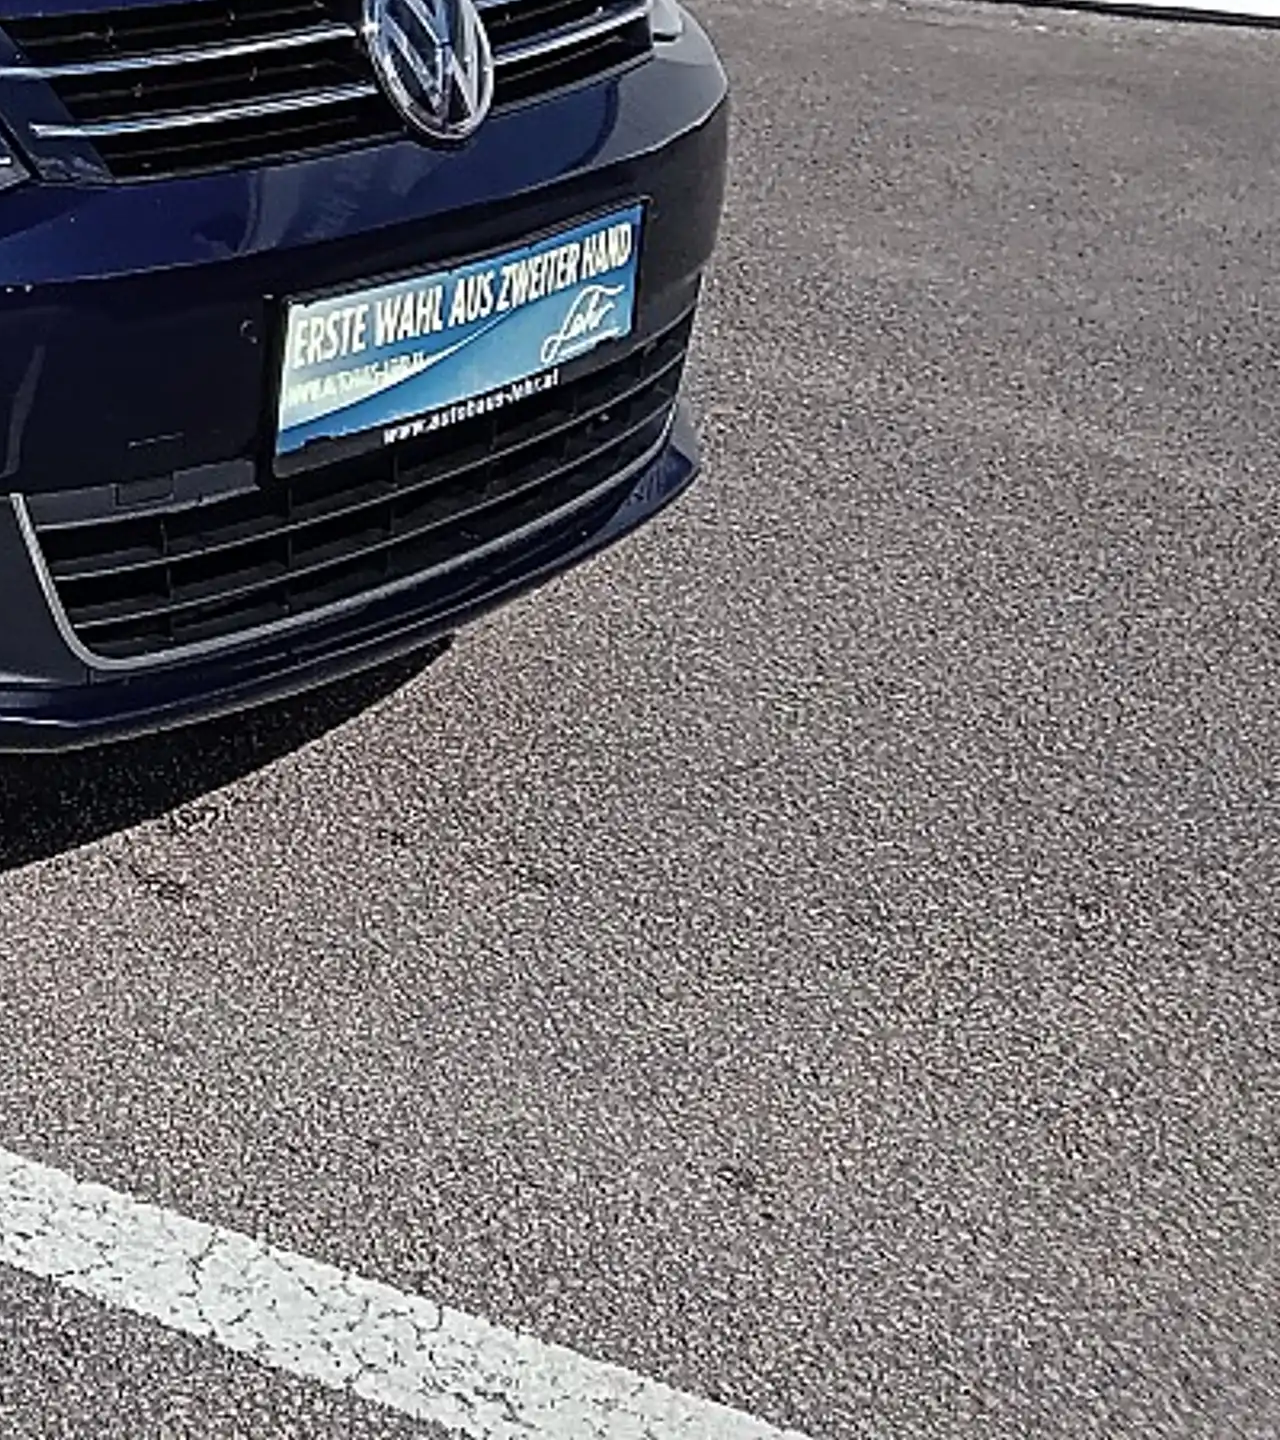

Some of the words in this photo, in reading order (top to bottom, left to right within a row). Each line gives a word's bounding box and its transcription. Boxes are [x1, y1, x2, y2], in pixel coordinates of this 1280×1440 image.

[294, 306, 368, 367] ERSTE
[376, 285, 443, 346] WAHL
[448, 270, 495, 327] AUS
[498, 243, 580, 308] ZWEITER
[581, 224, 632, 278] HAND
